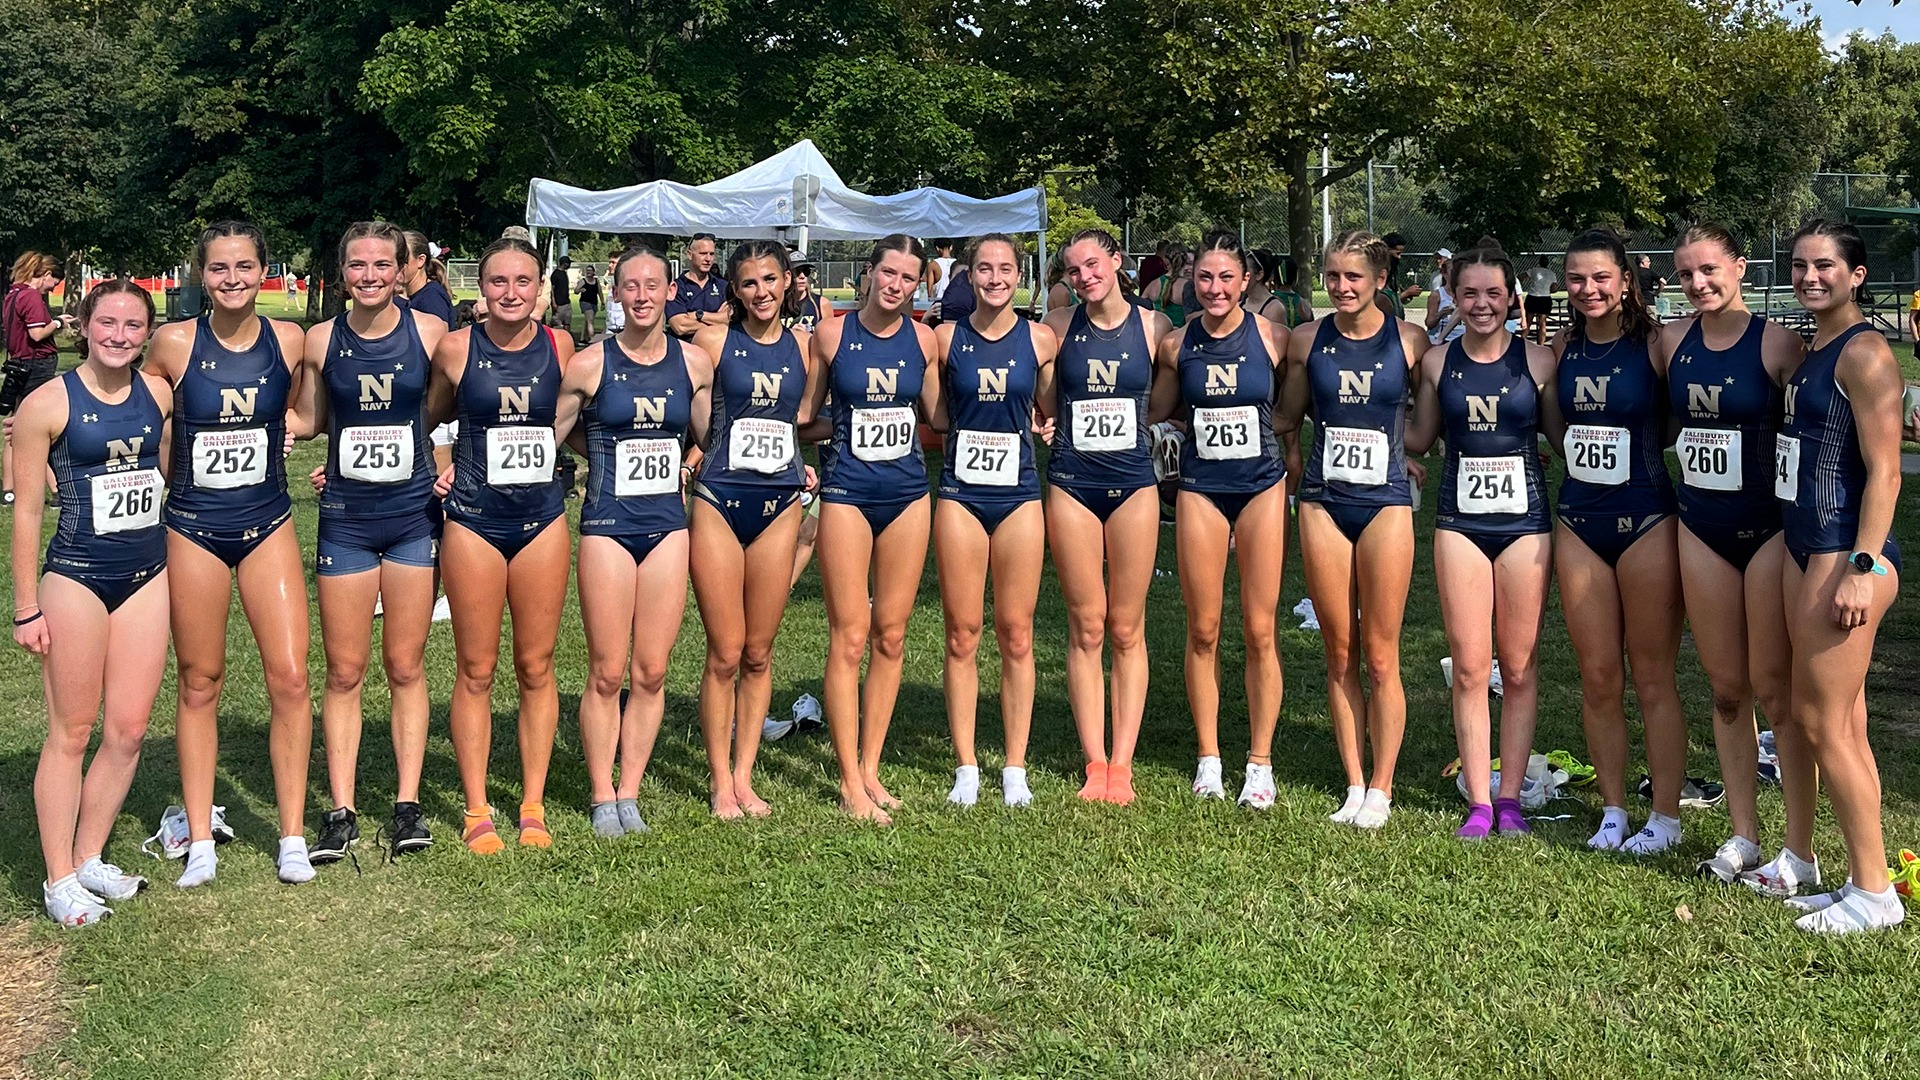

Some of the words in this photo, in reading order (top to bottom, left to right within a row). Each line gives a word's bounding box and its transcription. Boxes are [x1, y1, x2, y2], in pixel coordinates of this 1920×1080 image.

[866, 368, 899, 394] N
[978, 368, 1008, 393] N
[1087, 359, 1120, 385] N
[1205, 364, 1238, 388] N
[1339, 370, 1374, 395] N
[358, 373, 394, 402] N
[752, 372, 782, 399] N
[867, 394, 895, 402] NAVY
[1088, 385, 1115, 393] NAVY
[1206, 388, 1237, 396] NAVY
[1573, 376, 1610, 403] N
[1687, 383, 1722, 413] N
[220, 387, 258, 416] N
[360, 402, 391, 411] NAVY
[498, 386, 531, 414] N
[633, 397, 666, 422] N
[751, 399, 777, 407] NAVY
[1339, 396, 1369, 404] NAVY
[1466, 396, 1499, 422] N
[1575, 403, 1606, 411] NAVY
[499, 414, 528, 422] NAVY
[740, 426, 785, 435] UNIVERSITY
[1084, 414, 1126, 437] 262
[203, 438, 257, 446] UNIVERSITY
[742, 434, 783, 459] 255
[857, 422, 911, 448] 1209
[1205, 423, 1248, 446] 263
[1331, 436, 1380, 444] UNIVERSITY
[1332, 431, 1380, 439] SALISBURY
[1572, 434, 1620, 442] UNIVERSITY
[1684, 431, 1731, 439] SALISBURY
[1684, 437, 1730, 445] UNIVERSITY
[106, 437, 144, 466] N
[206, 447, 255, 474] 252
[353, 443, 400, 468] 253
[501, 443, 545, 469] 259
[966, 447, 1008, 471] 257
[1333, 444, 1373, 470] 261
[1574, 442, 1616, 470] 265
[1685, 446, 1727, 475] 260
[103, 473, 153, 484] SALISBURY
[628, 455, 670, 480] 268
[104, 479, 155, 490] UNIVERSITY
[1468, 474, 1515, 499] 254
[109, 487, 153, 518] 266
[1618, 517, 1632, 528] N
